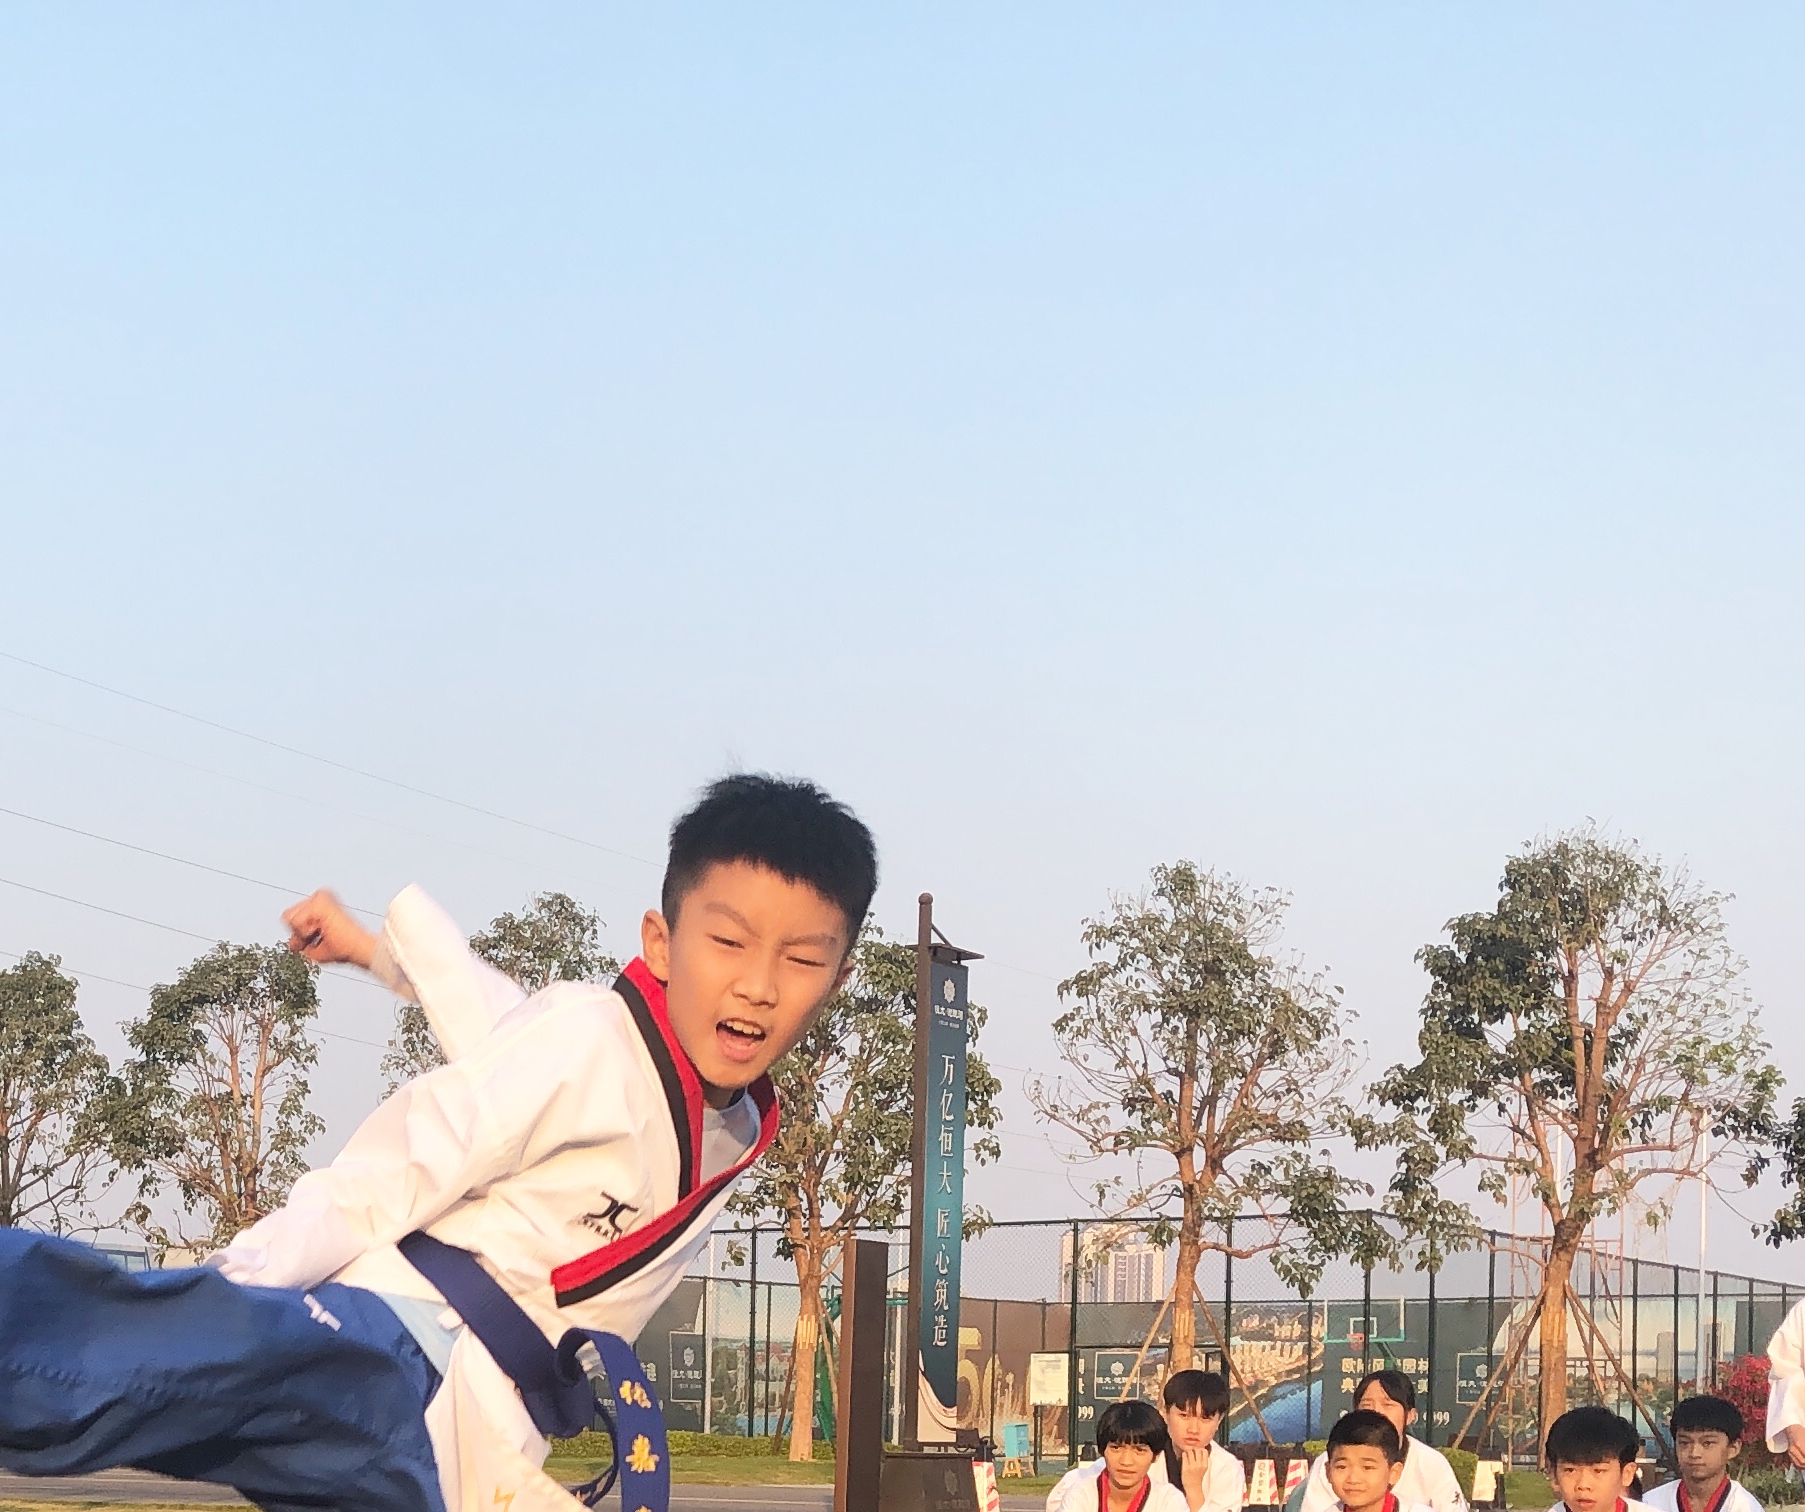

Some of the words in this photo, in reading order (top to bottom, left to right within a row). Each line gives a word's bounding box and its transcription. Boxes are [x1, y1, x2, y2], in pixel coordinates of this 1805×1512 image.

[937, 1054, 956, 1195] 万亿恒大
[932, 1208, 951, 1347] 匠心筑造
